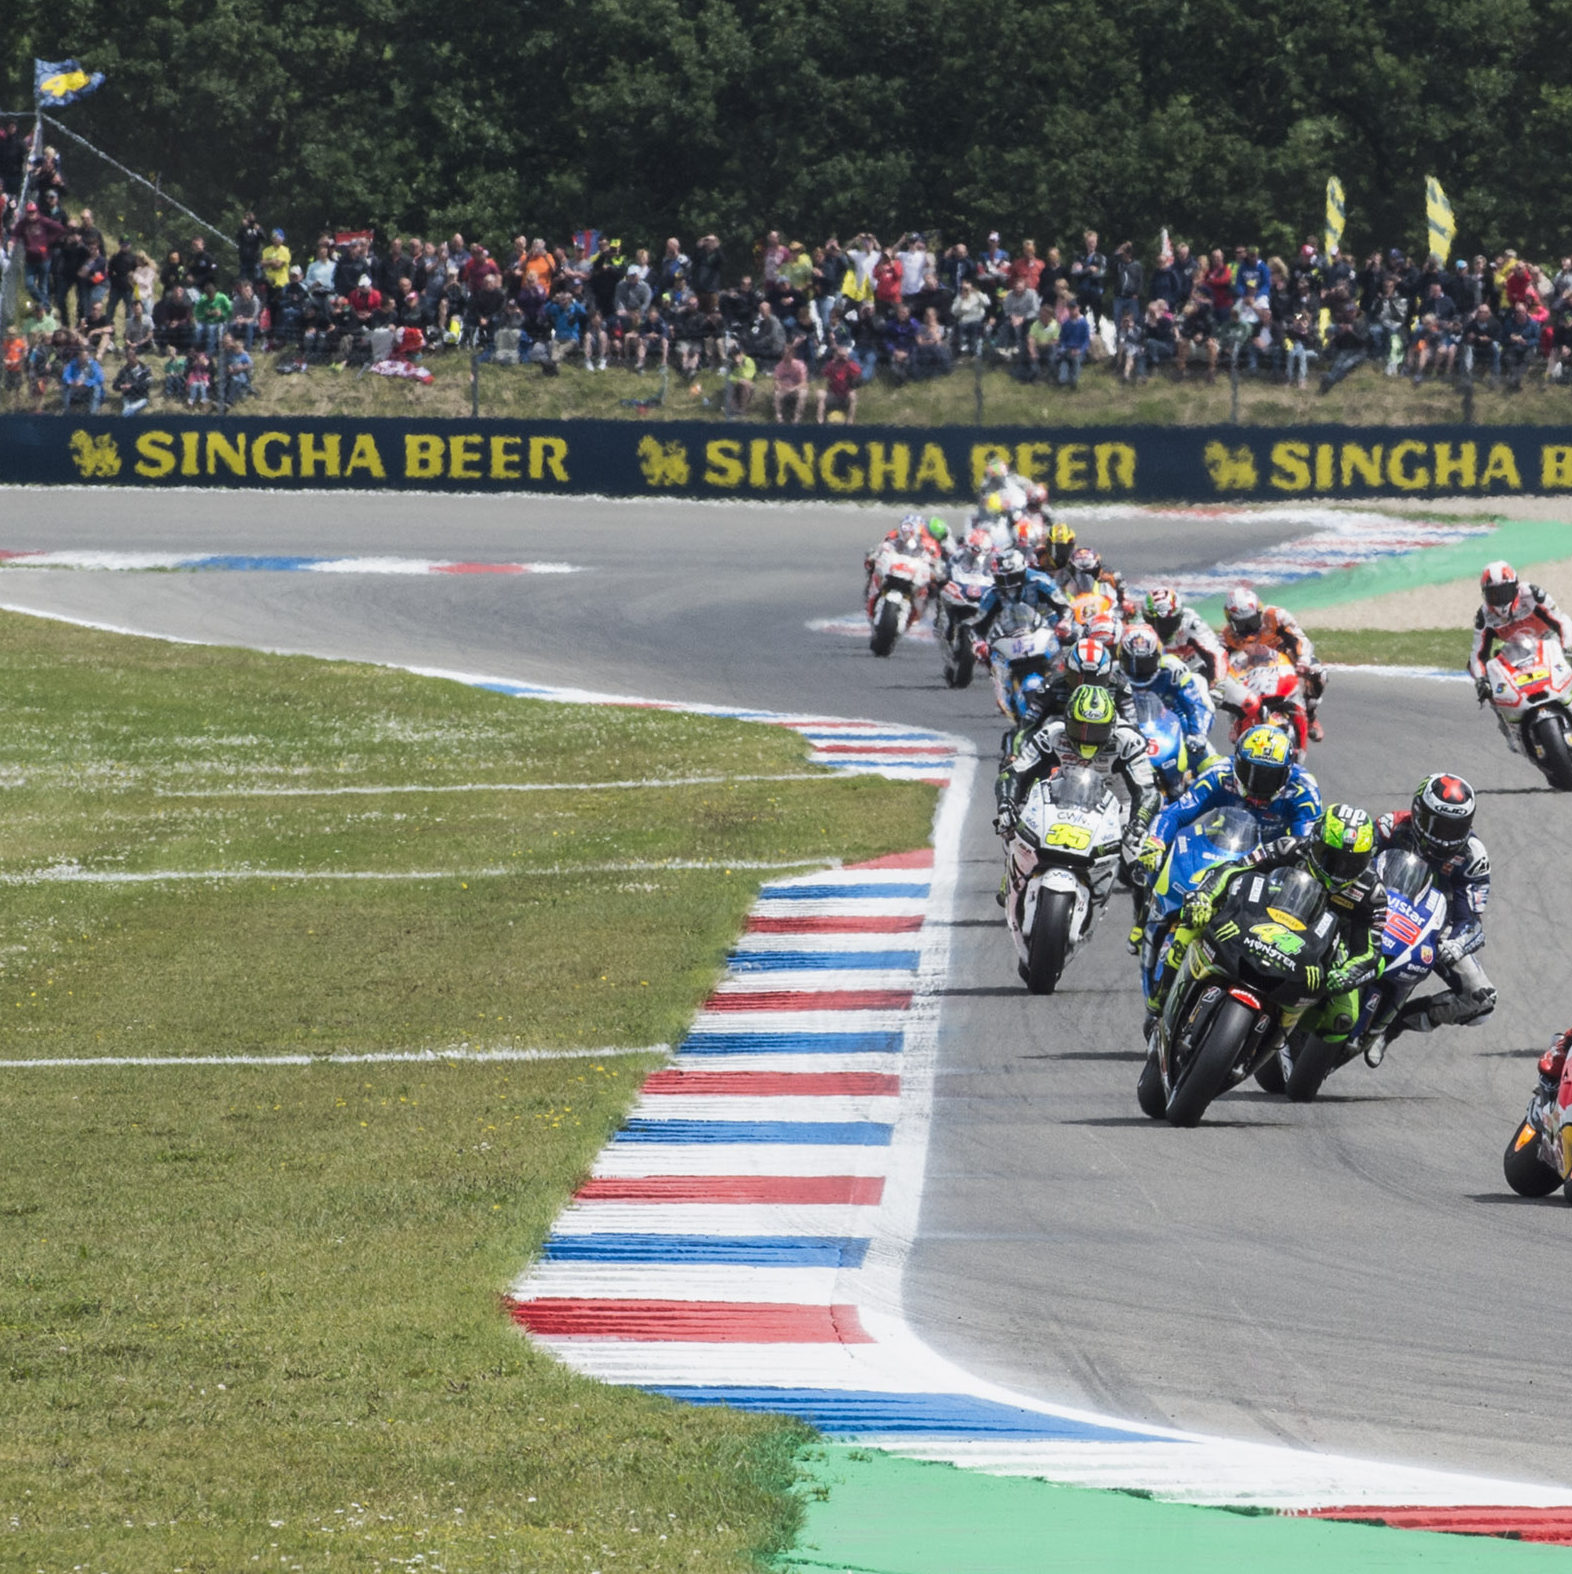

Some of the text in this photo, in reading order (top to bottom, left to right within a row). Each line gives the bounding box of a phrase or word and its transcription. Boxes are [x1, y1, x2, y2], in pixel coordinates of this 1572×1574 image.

[135, 431, 569, 481] SINGHA BEER
[705, 440, 954, 490] SINGHA
[1270, 441, 1521, 490] SINGHA
[1338, 804, 1367, 827] hp
[1045, 823, 1093, 851] 35
[1249, 922, 1306, 955] 44
